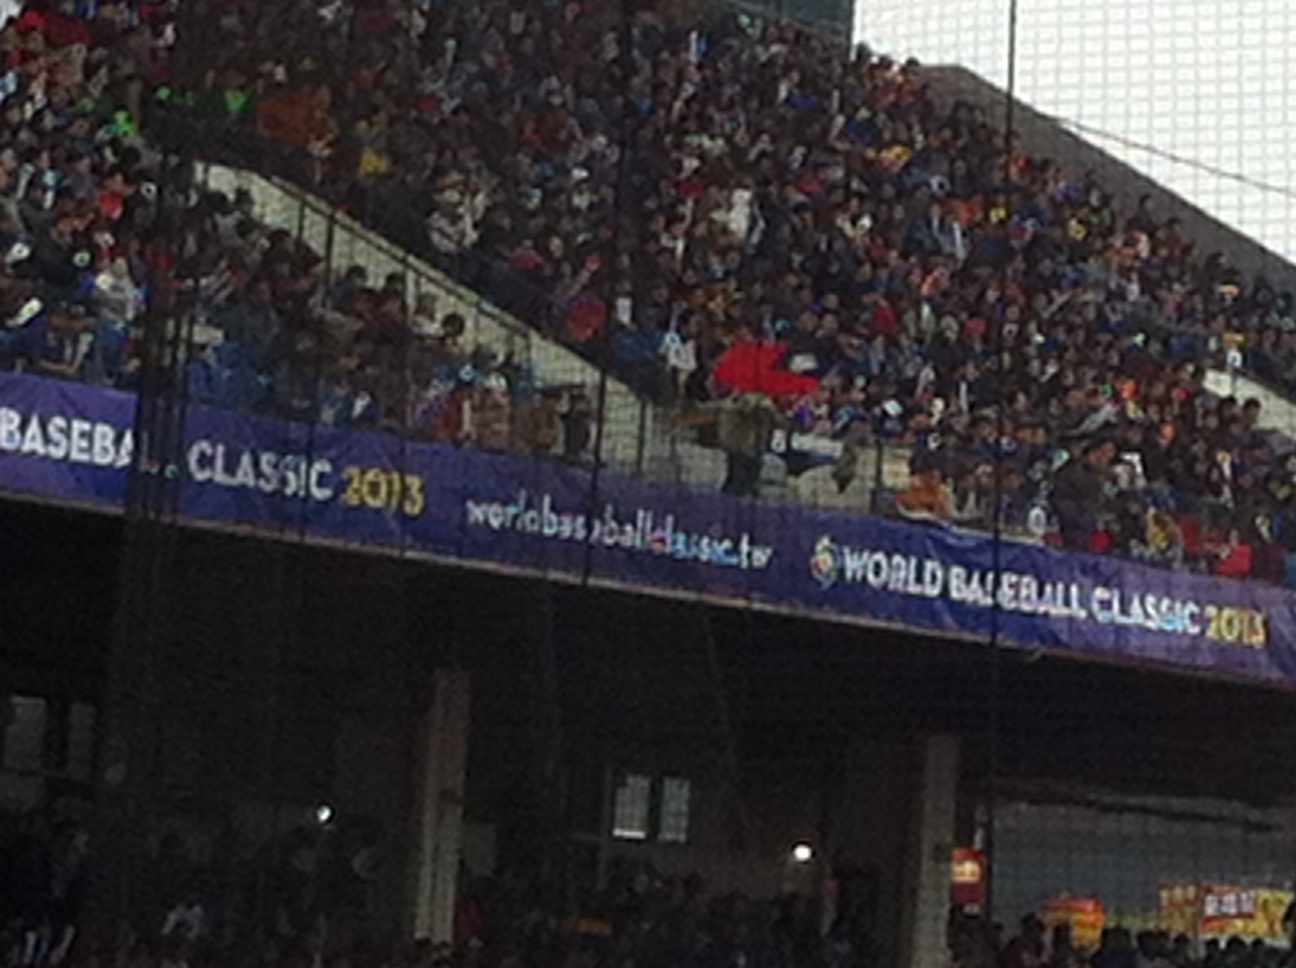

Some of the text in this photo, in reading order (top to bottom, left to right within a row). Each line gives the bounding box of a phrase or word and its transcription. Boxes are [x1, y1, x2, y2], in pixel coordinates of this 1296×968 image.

[0, 407, 425, 515] BASEBA CLASSIC 2013
[842, 546, 943, 598] WORLD
[1092, 586, 1201, 635] CLASSIC
[1204, 605, 1267, 650] 2013
